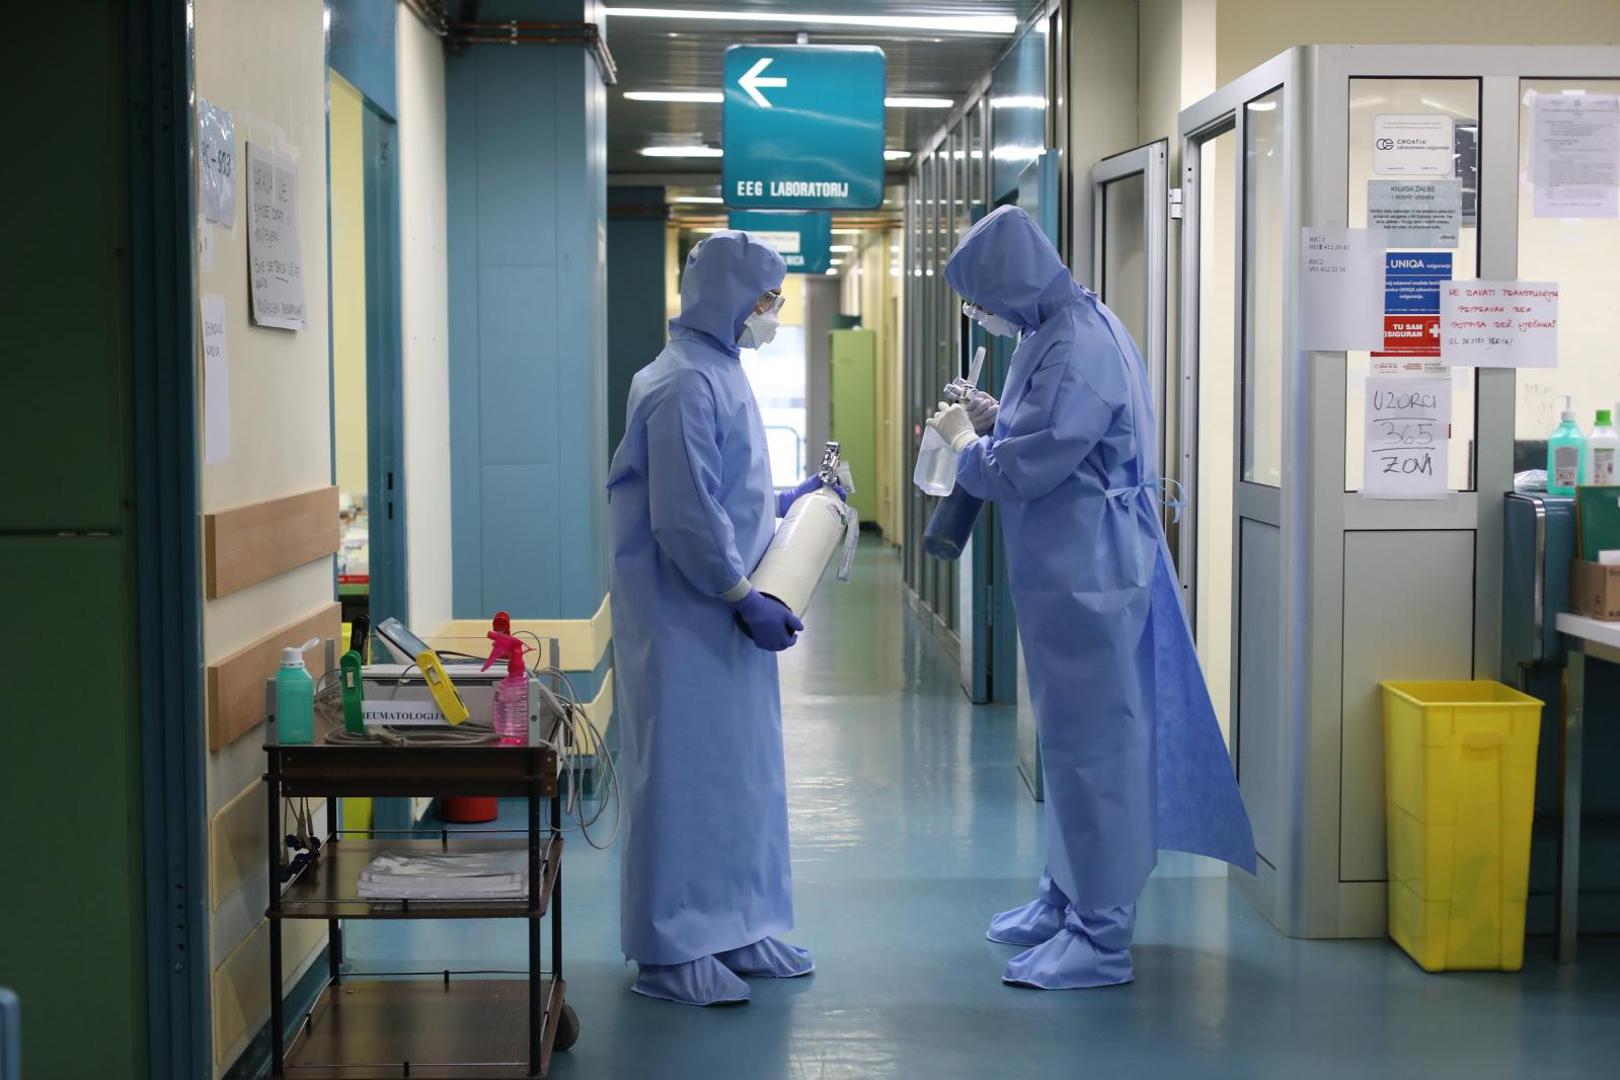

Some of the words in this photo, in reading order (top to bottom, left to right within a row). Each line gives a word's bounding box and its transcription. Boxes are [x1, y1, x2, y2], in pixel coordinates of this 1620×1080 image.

[737, 181, 763, 196] EEG
[770, 181, 849, 198] LABORATORIJ
[1390, 185, 1413, 193] KNJIGA
[1390, 259, 1425, 269] UNIQA
[1448, 288, 1460, 296] NE
[1465, 289, 1496, 297] DAVATI
[1373, 390, 1437, 411] UZORCI
[1380, 421, 1433, 445] 365
